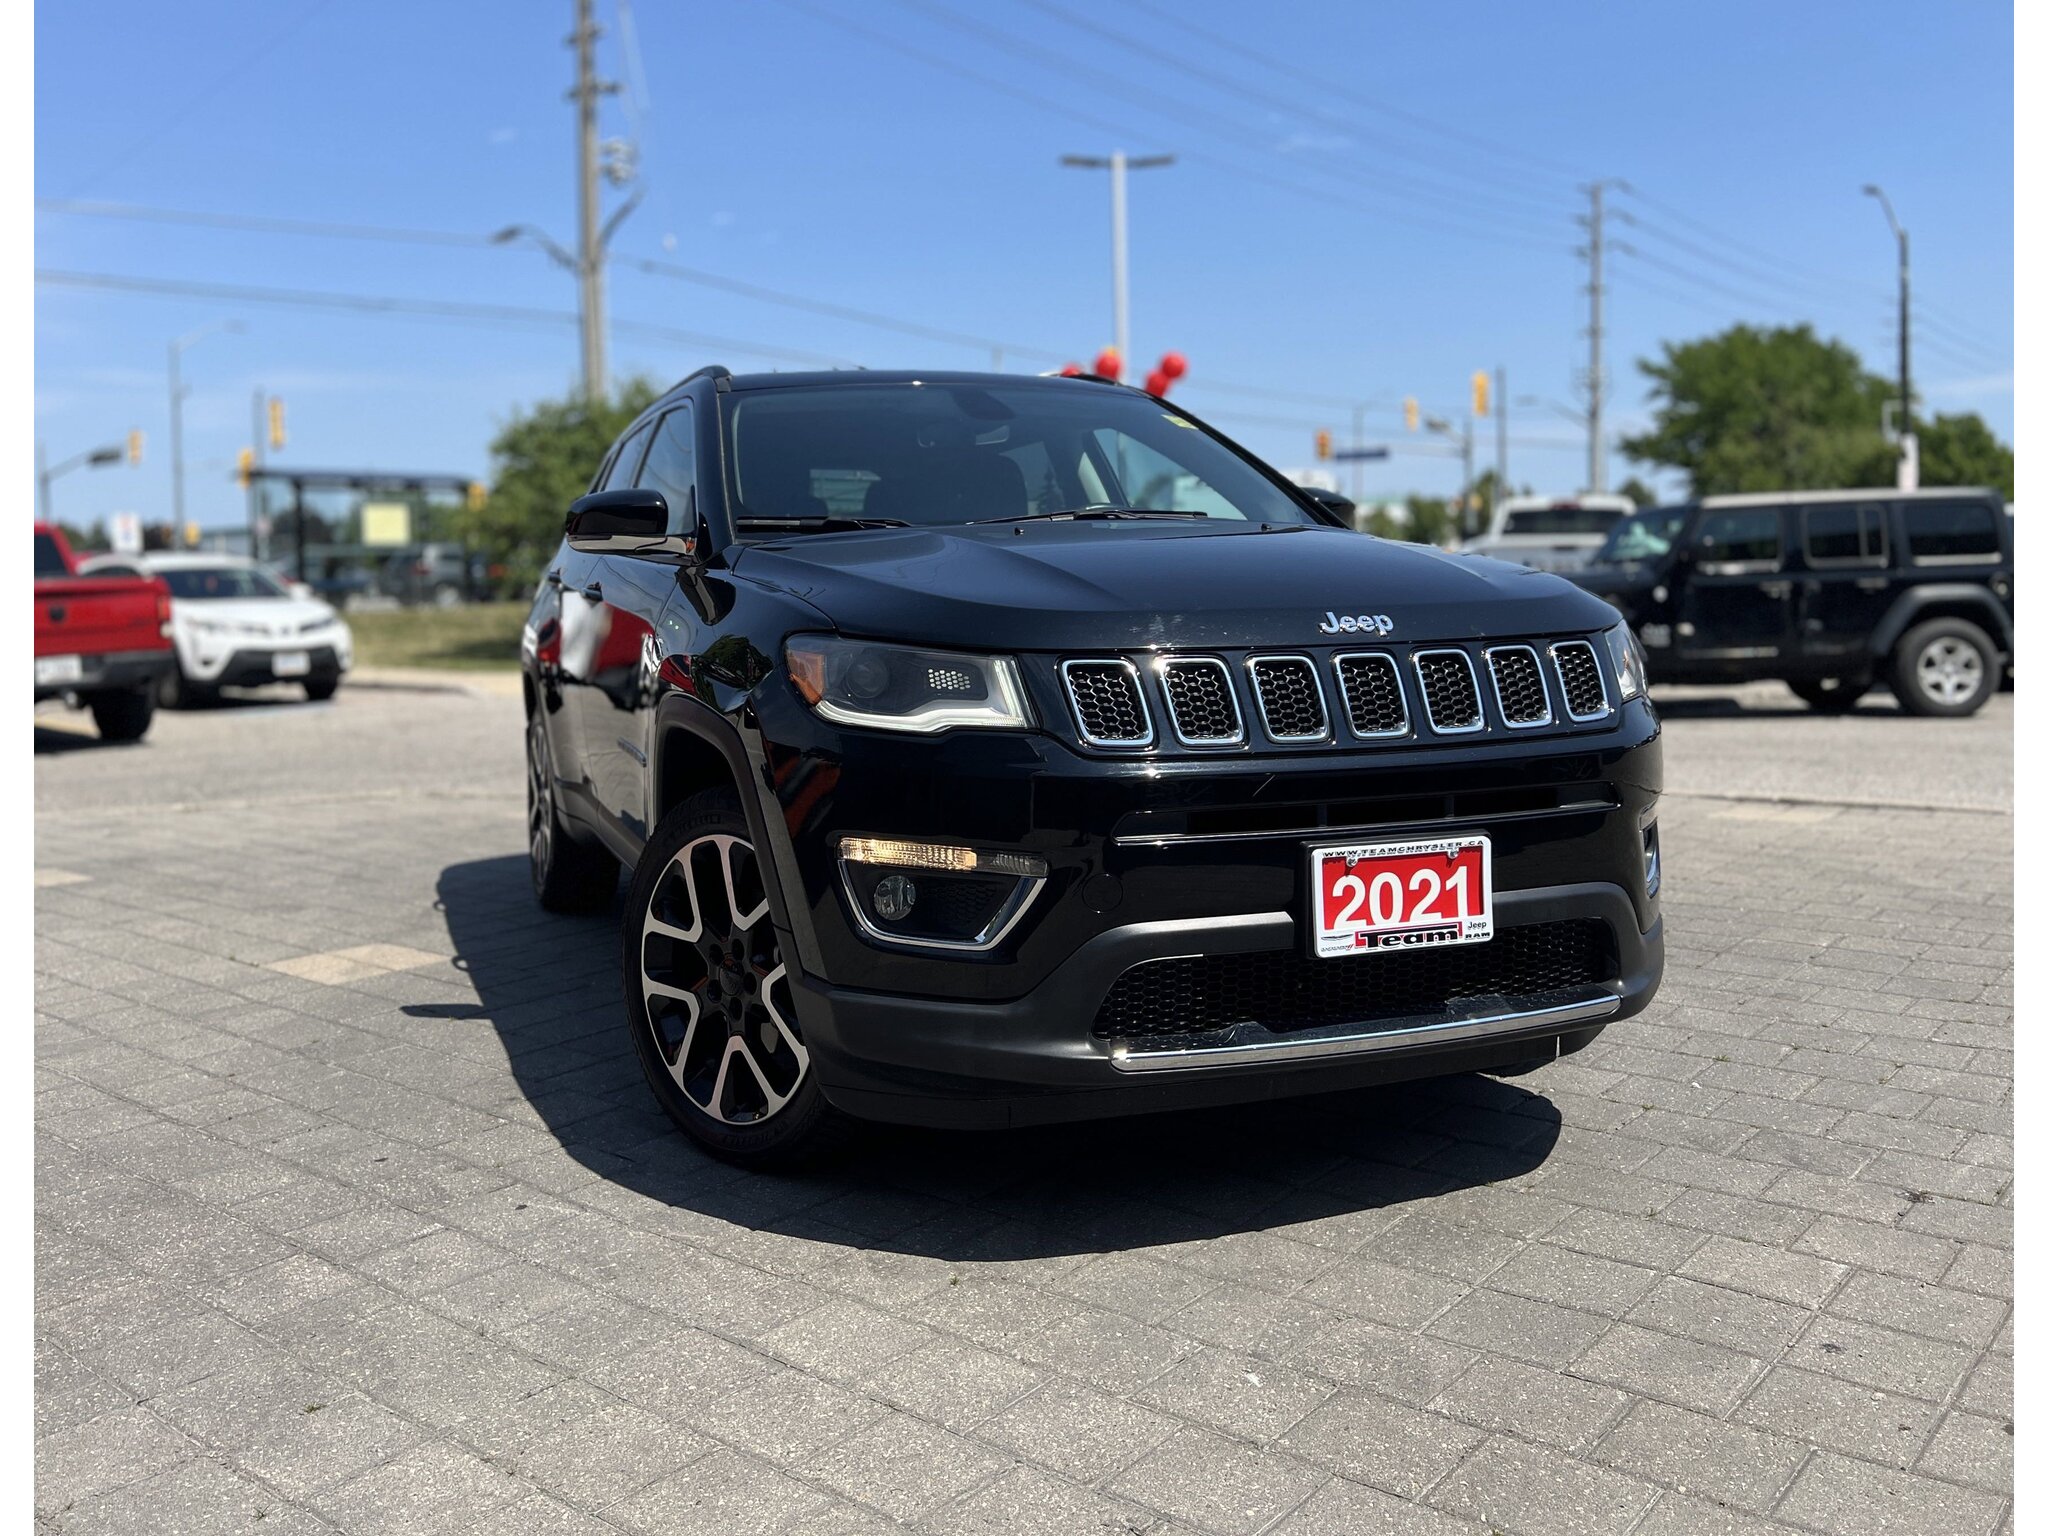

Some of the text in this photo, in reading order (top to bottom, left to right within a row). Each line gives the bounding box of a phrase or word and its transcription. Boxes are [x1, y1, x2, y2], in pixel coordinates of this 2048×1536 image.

[1319, 611, 1394, 637] Jeep
[1332, 865, 1468, 930] 2021
[1360, 924, 1458, 948] Team
[1465, 932, 1490, 940] RAM
[1467, 921, 1487, 930] Jeep
